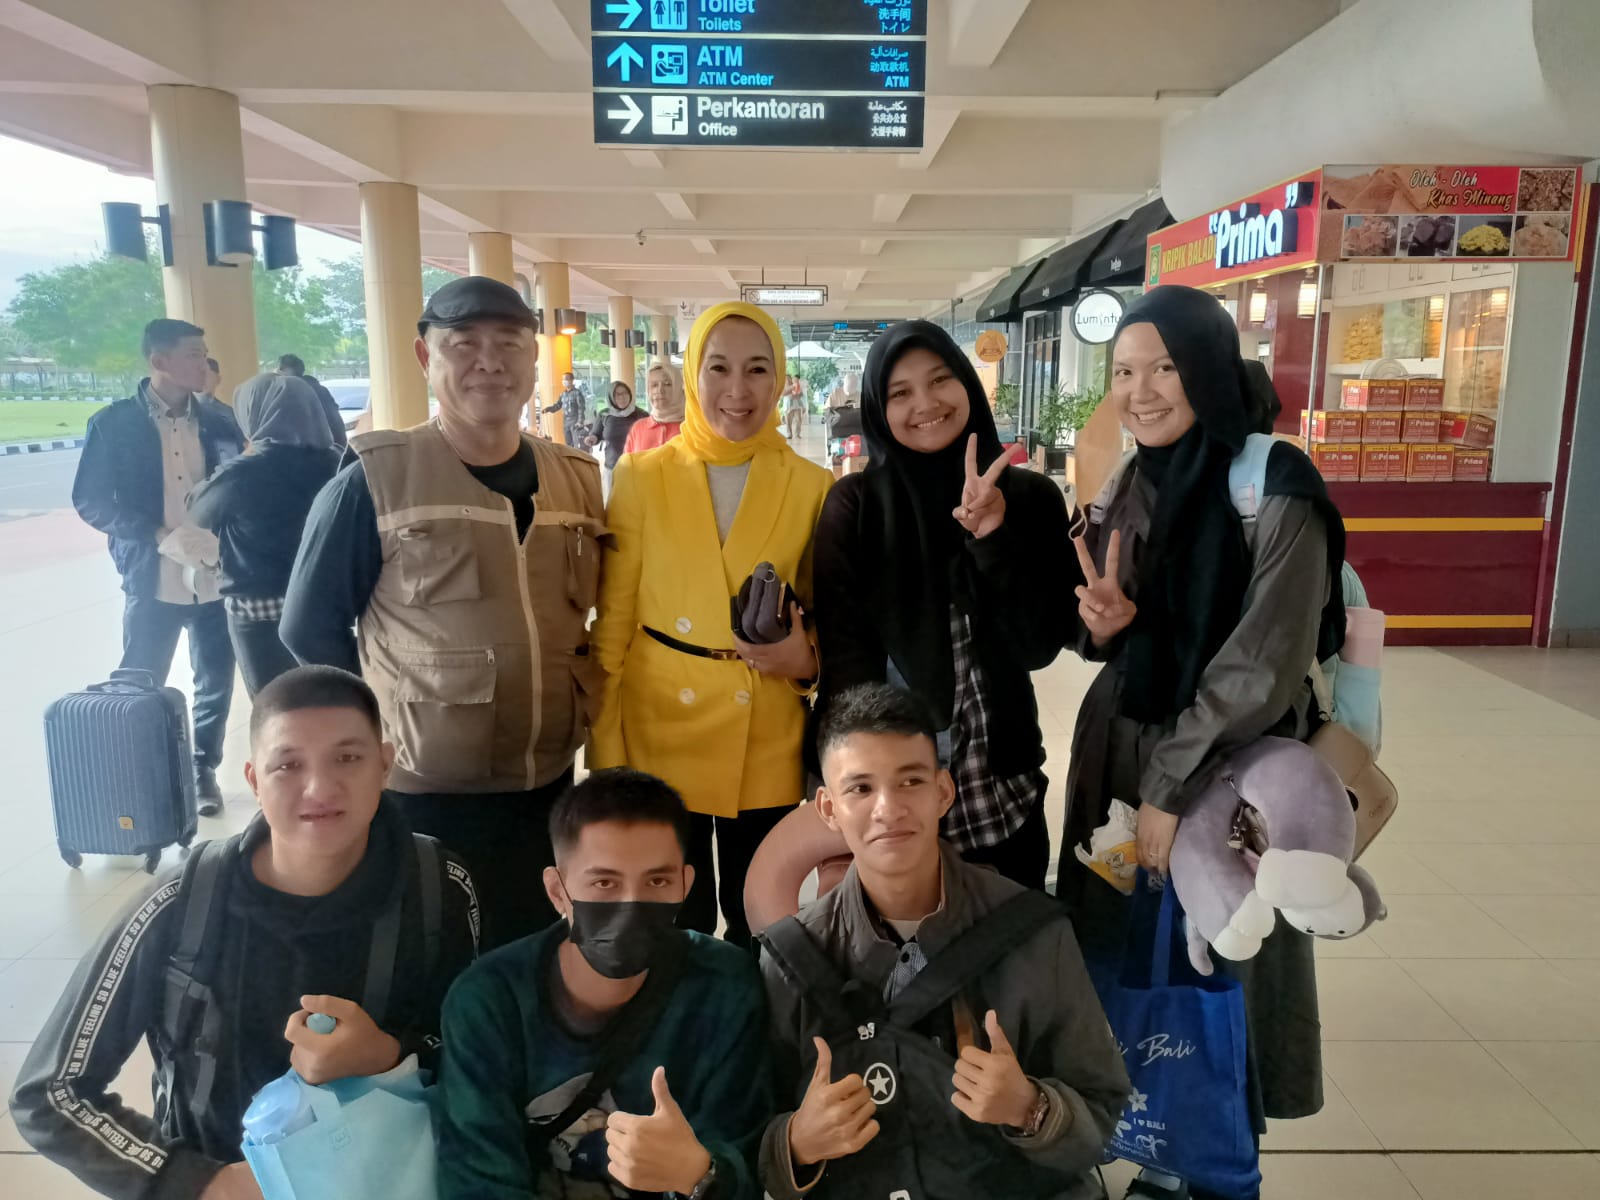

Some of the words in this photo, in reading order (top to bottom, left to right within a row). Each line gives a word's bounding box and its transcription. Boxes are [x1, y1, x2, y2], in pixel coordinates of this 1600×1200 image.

[698, 17, 742, 31] Toilets
[878, 8, 911, 21] 洗手间
[881, 22, 910, 33] トイレ
[697, 45, 742, 67] ATM
[699, 71, 727, 85] ATM
[730, 72, 774, 86] Center
[884, 75, 909, 88] ATM
[697, 96, 825, 119] Perkantoran
[698, 122, 738, 136] Office
[1409, 169, 1437, 188] Oleh
[1450, 169, 1478, 188] Oleh
[1426, 188, 1459, 209] Khas
[1463, 188, 1514, 211] Minang
[1162, 242, 1186, 273] KRIPIK
[1188, 235, 1217, 267] BALAD
[138, 900, 158, 923] BLUE
[129, 921, 141, 936] SO
[114, 935, 133, 968] FEELING
[103, 965, 119, 989] BLUE
[97, 990, 110, 1002] SO
[82, 1003, 104, 1036] FEELING
[73, 1036, 90, 1059] BLUE
[1136, 1033, 1196, 1066] Bali
[69, 1061, 82, 1075] SO
